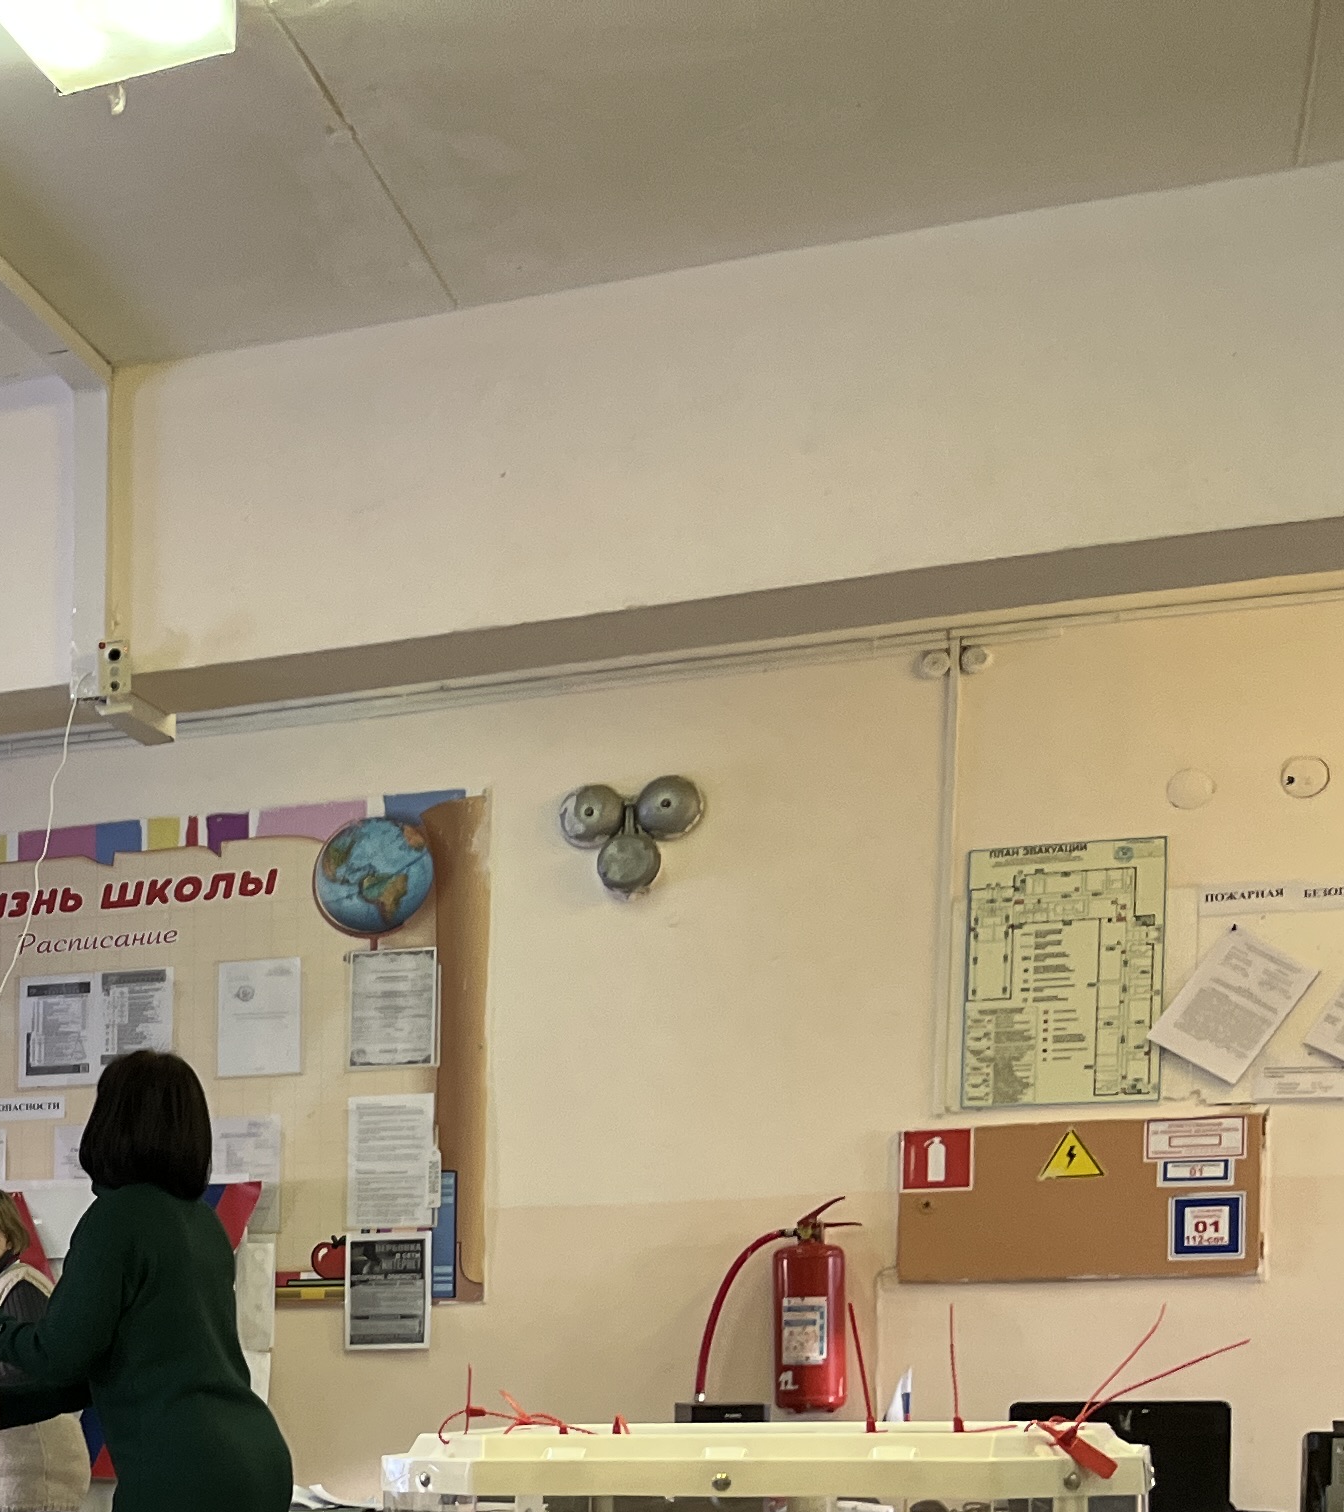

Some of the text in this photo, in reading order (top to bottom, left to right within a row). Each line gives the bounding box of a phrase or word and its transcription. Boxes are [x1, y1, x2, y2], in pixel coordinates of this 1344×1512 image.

[989, 847, 1020, 859] ПЛАН
[100, 868, 279, 910] школы
[1204, 887, 1284, 903] ПОЖАРНАЯ
[16, 928, 179, 956] Расписание
[1194, 1220, 1220, 1234] 01
